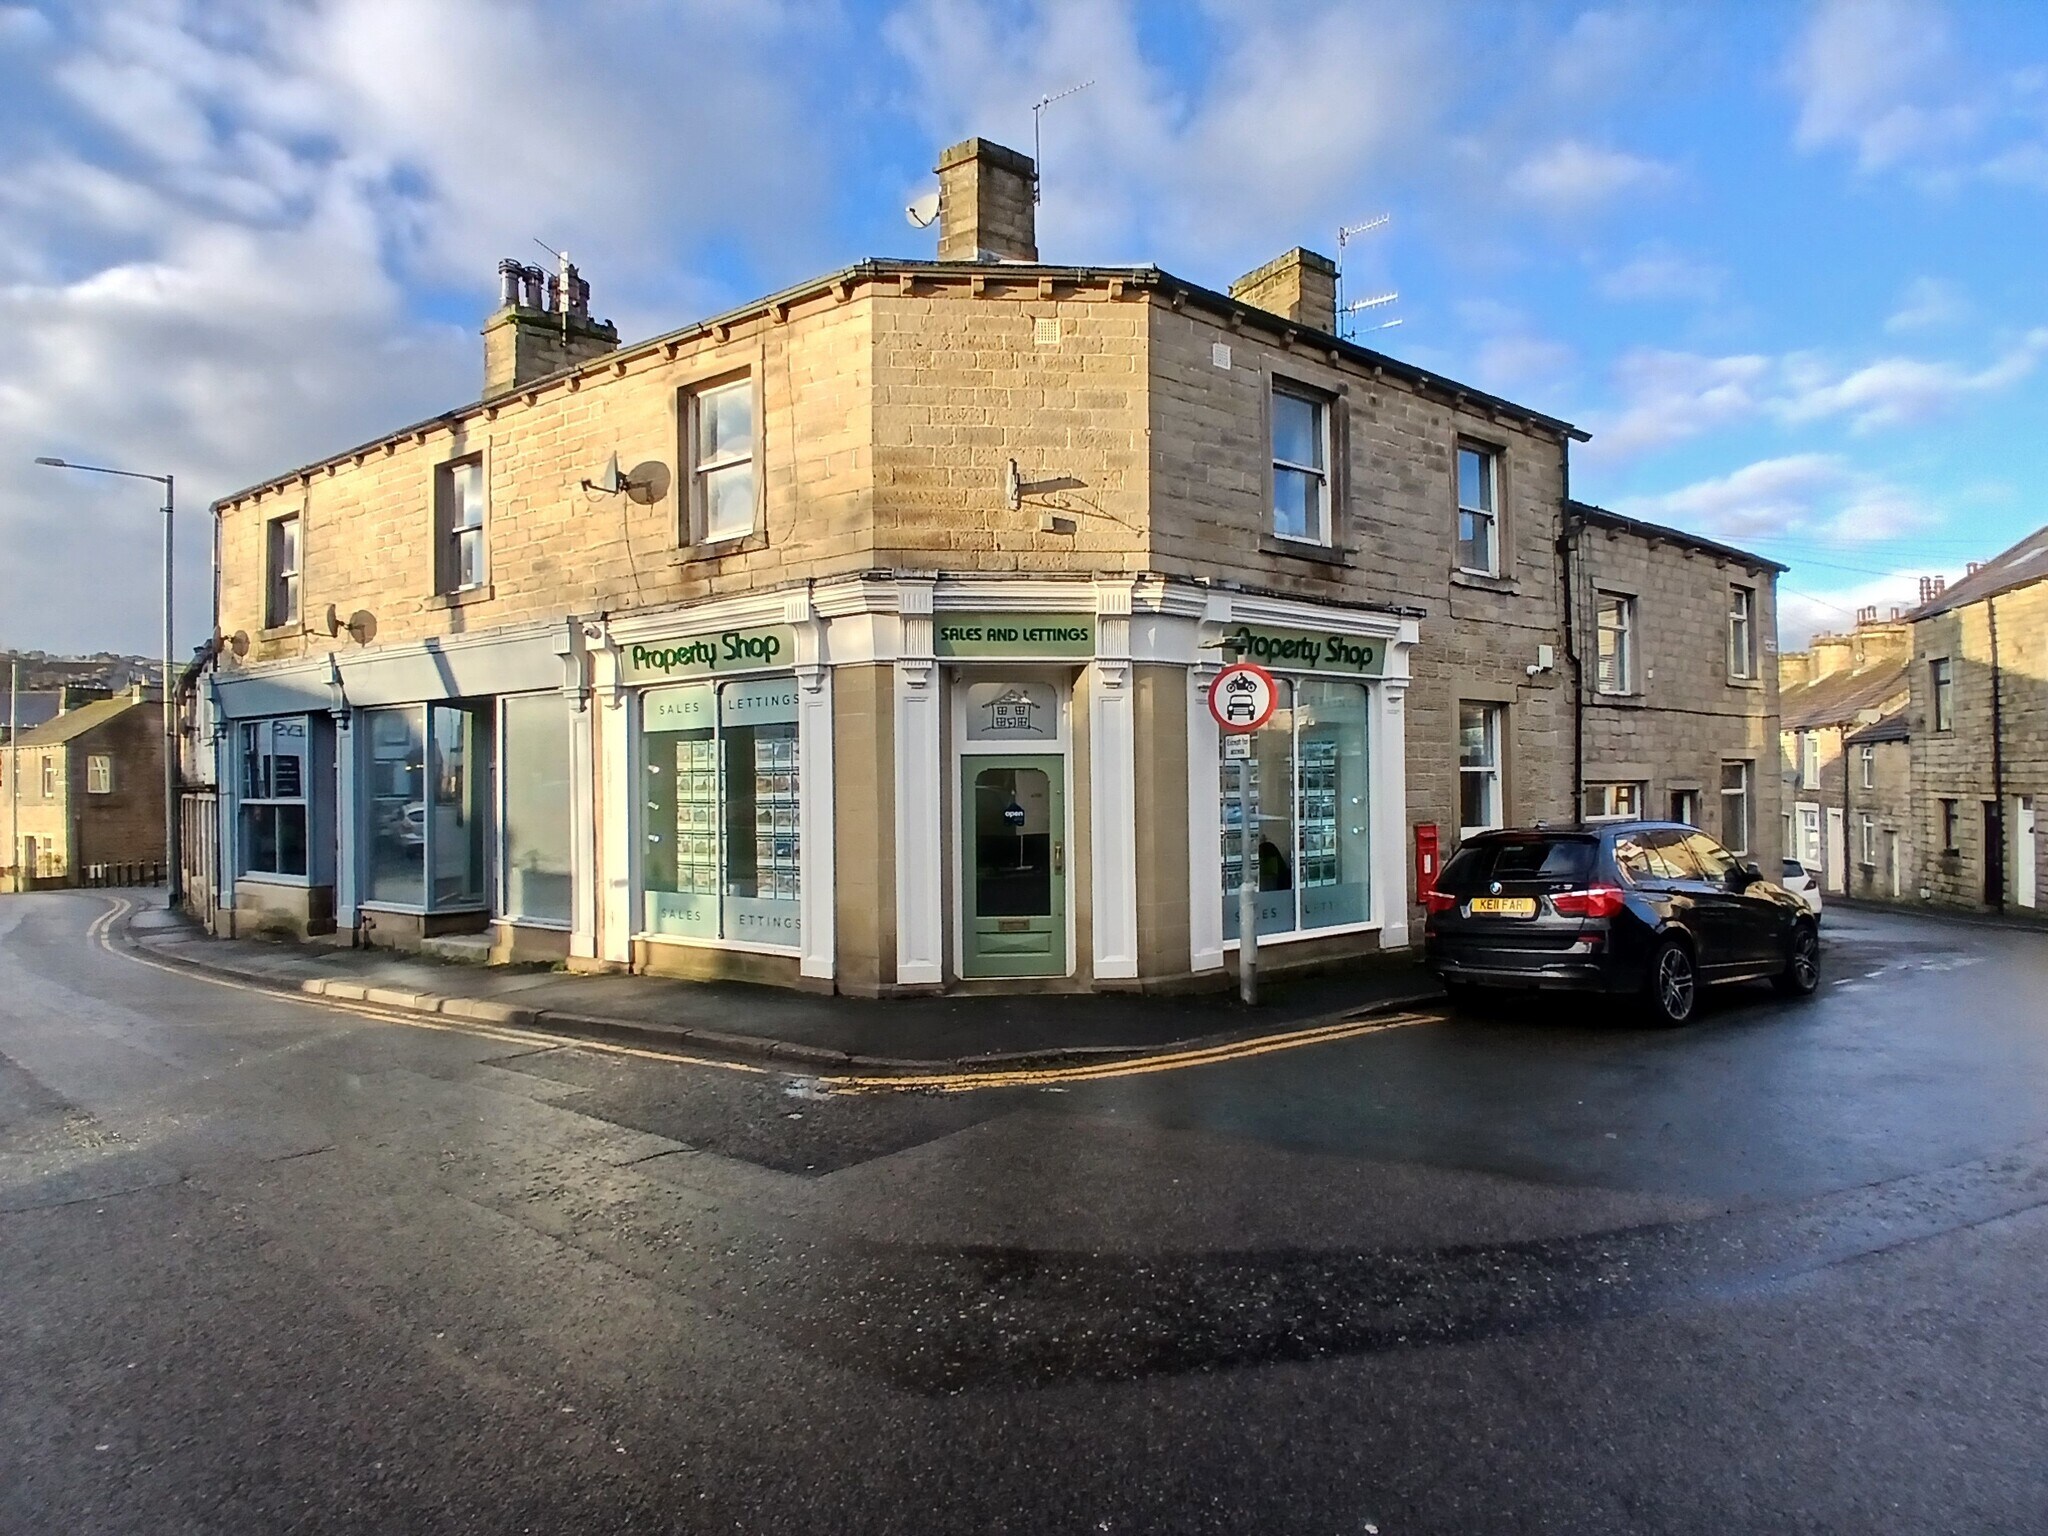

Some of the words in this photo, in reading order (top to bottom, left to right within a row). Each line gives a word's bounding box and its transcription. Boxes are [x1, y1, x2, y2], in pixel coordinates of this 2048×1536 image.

[940, 627, 982, 641] SALES
[987, 628, 1018, 641] AND
[1023, 628, 1088, 641] LETTINGS
[633, 641, 718, 674] Property
[722, 633, 780, 664] Shop
[1325, 636, 1373, 670] Shop
[659, 702, 700, 715] SALES
[728, 694, 799, 710] LETTINGS
[1501, 899, 1523, 910] FAR
[661, 907, 701, 921] SALES
